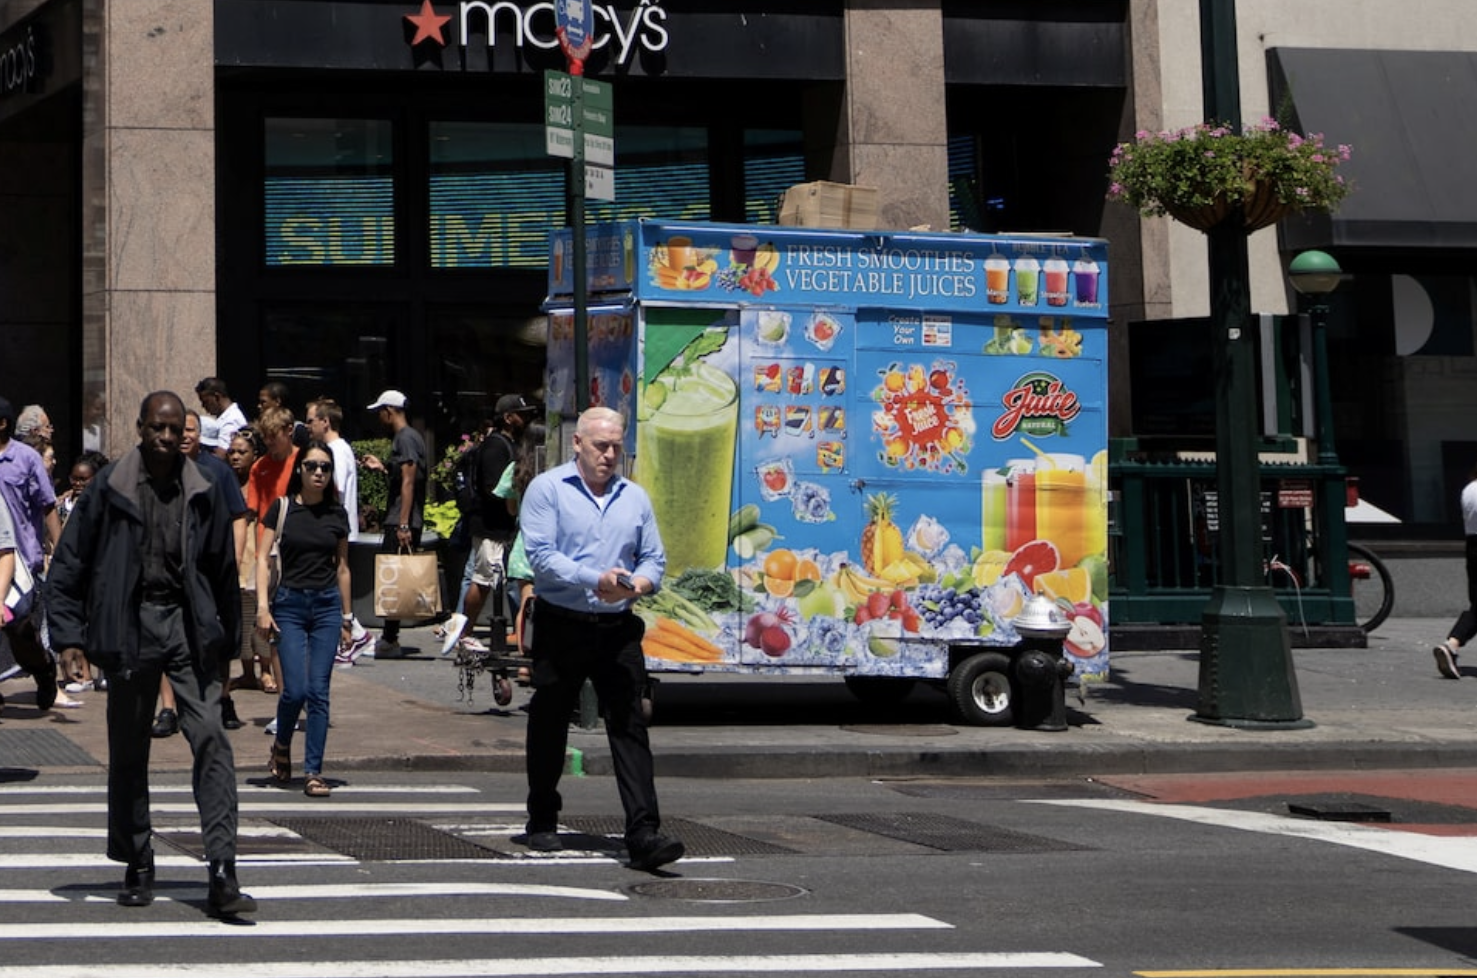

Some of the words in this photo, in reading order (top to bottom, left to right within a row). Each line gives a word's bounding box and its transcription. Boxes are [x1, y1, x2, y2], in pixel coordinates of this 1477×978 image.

[786, 245, 852, 267] FRESH
[858, 247, 975, 272] SMOOTHES
[786, 268, 905, 294] VEGETABLE
[908, 272, 976, 299] JUICES
[894, 325, 916, 335] Your
[894, 335, 914, 345] Own
[992, 381, 1081, 441] Juice
